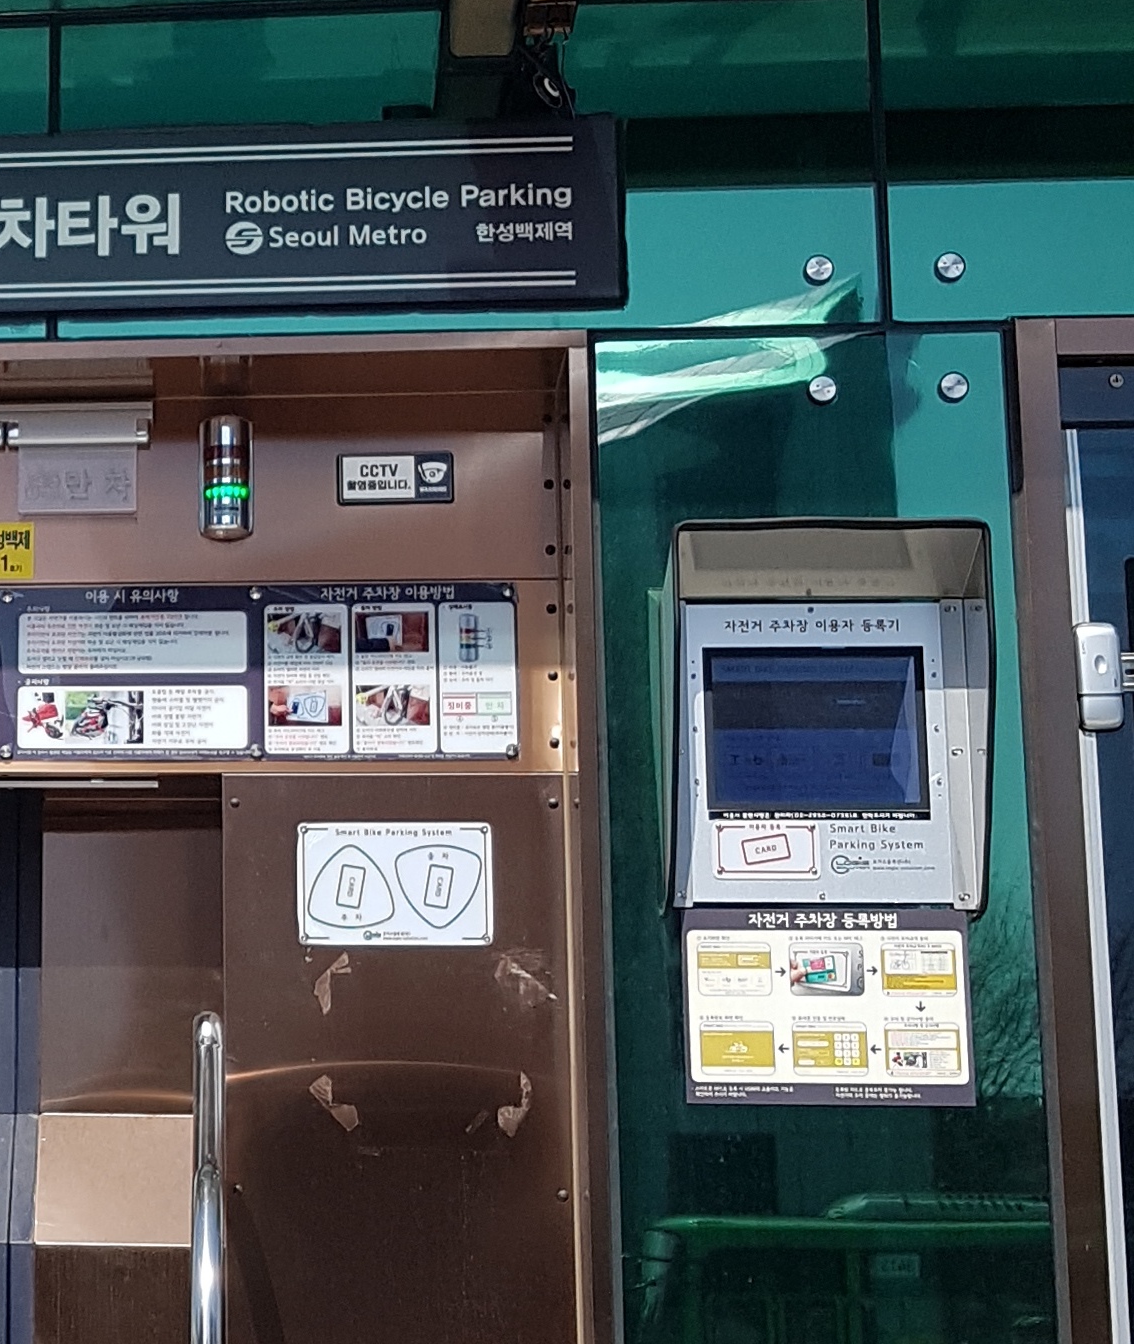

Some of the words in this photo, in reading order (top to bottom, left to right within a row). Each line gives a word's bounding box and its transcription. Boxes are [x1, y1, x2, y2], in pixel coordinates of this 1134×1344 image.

[225, 189, 338, 214] Robotic
[344, 185, 450, 212] Bicycle
[460, 182, 573, 210] Parking
[267, 223, 340, 249] Seoul
[346, 222, 427, 247] Metro
[475, 220, 573, 244] 한성백제역
[360, 464, 398, 478] CCTV
[85, 590, 110, 603] 이용
[114, 590, 126, 603] 시
[130, 588, 179, 603] 유의사항
[320, 587, 358, 601] 자전거
[362, 586, 401, 600] 주차장
[405, 585, 456, 600] 이용방법
[724, 619, 764, 633] 자전거
[768, 619, 810, 633] 주차장
[814, 619, 854, 633] 이용자
[860, 619, 901, 633] 등록기
[335, 828, 361, 836] Smart
[363, 828, 382, 836] Bike
[385, 829, 418, 837] Parking
[421, 829, 453, 837] System
[829, 824, 865, 834] Smart
[871, 823, 896, 833] Bike
[755, 844, 778, 855] CARD
[829, 840, 875, 851] Parking
[880, 840, 924, 851] System
[748, 913, 790, 928] 자전거
[794, 912, 838, 928] 주차장
[841, 912, 898, 929] 등록방법
